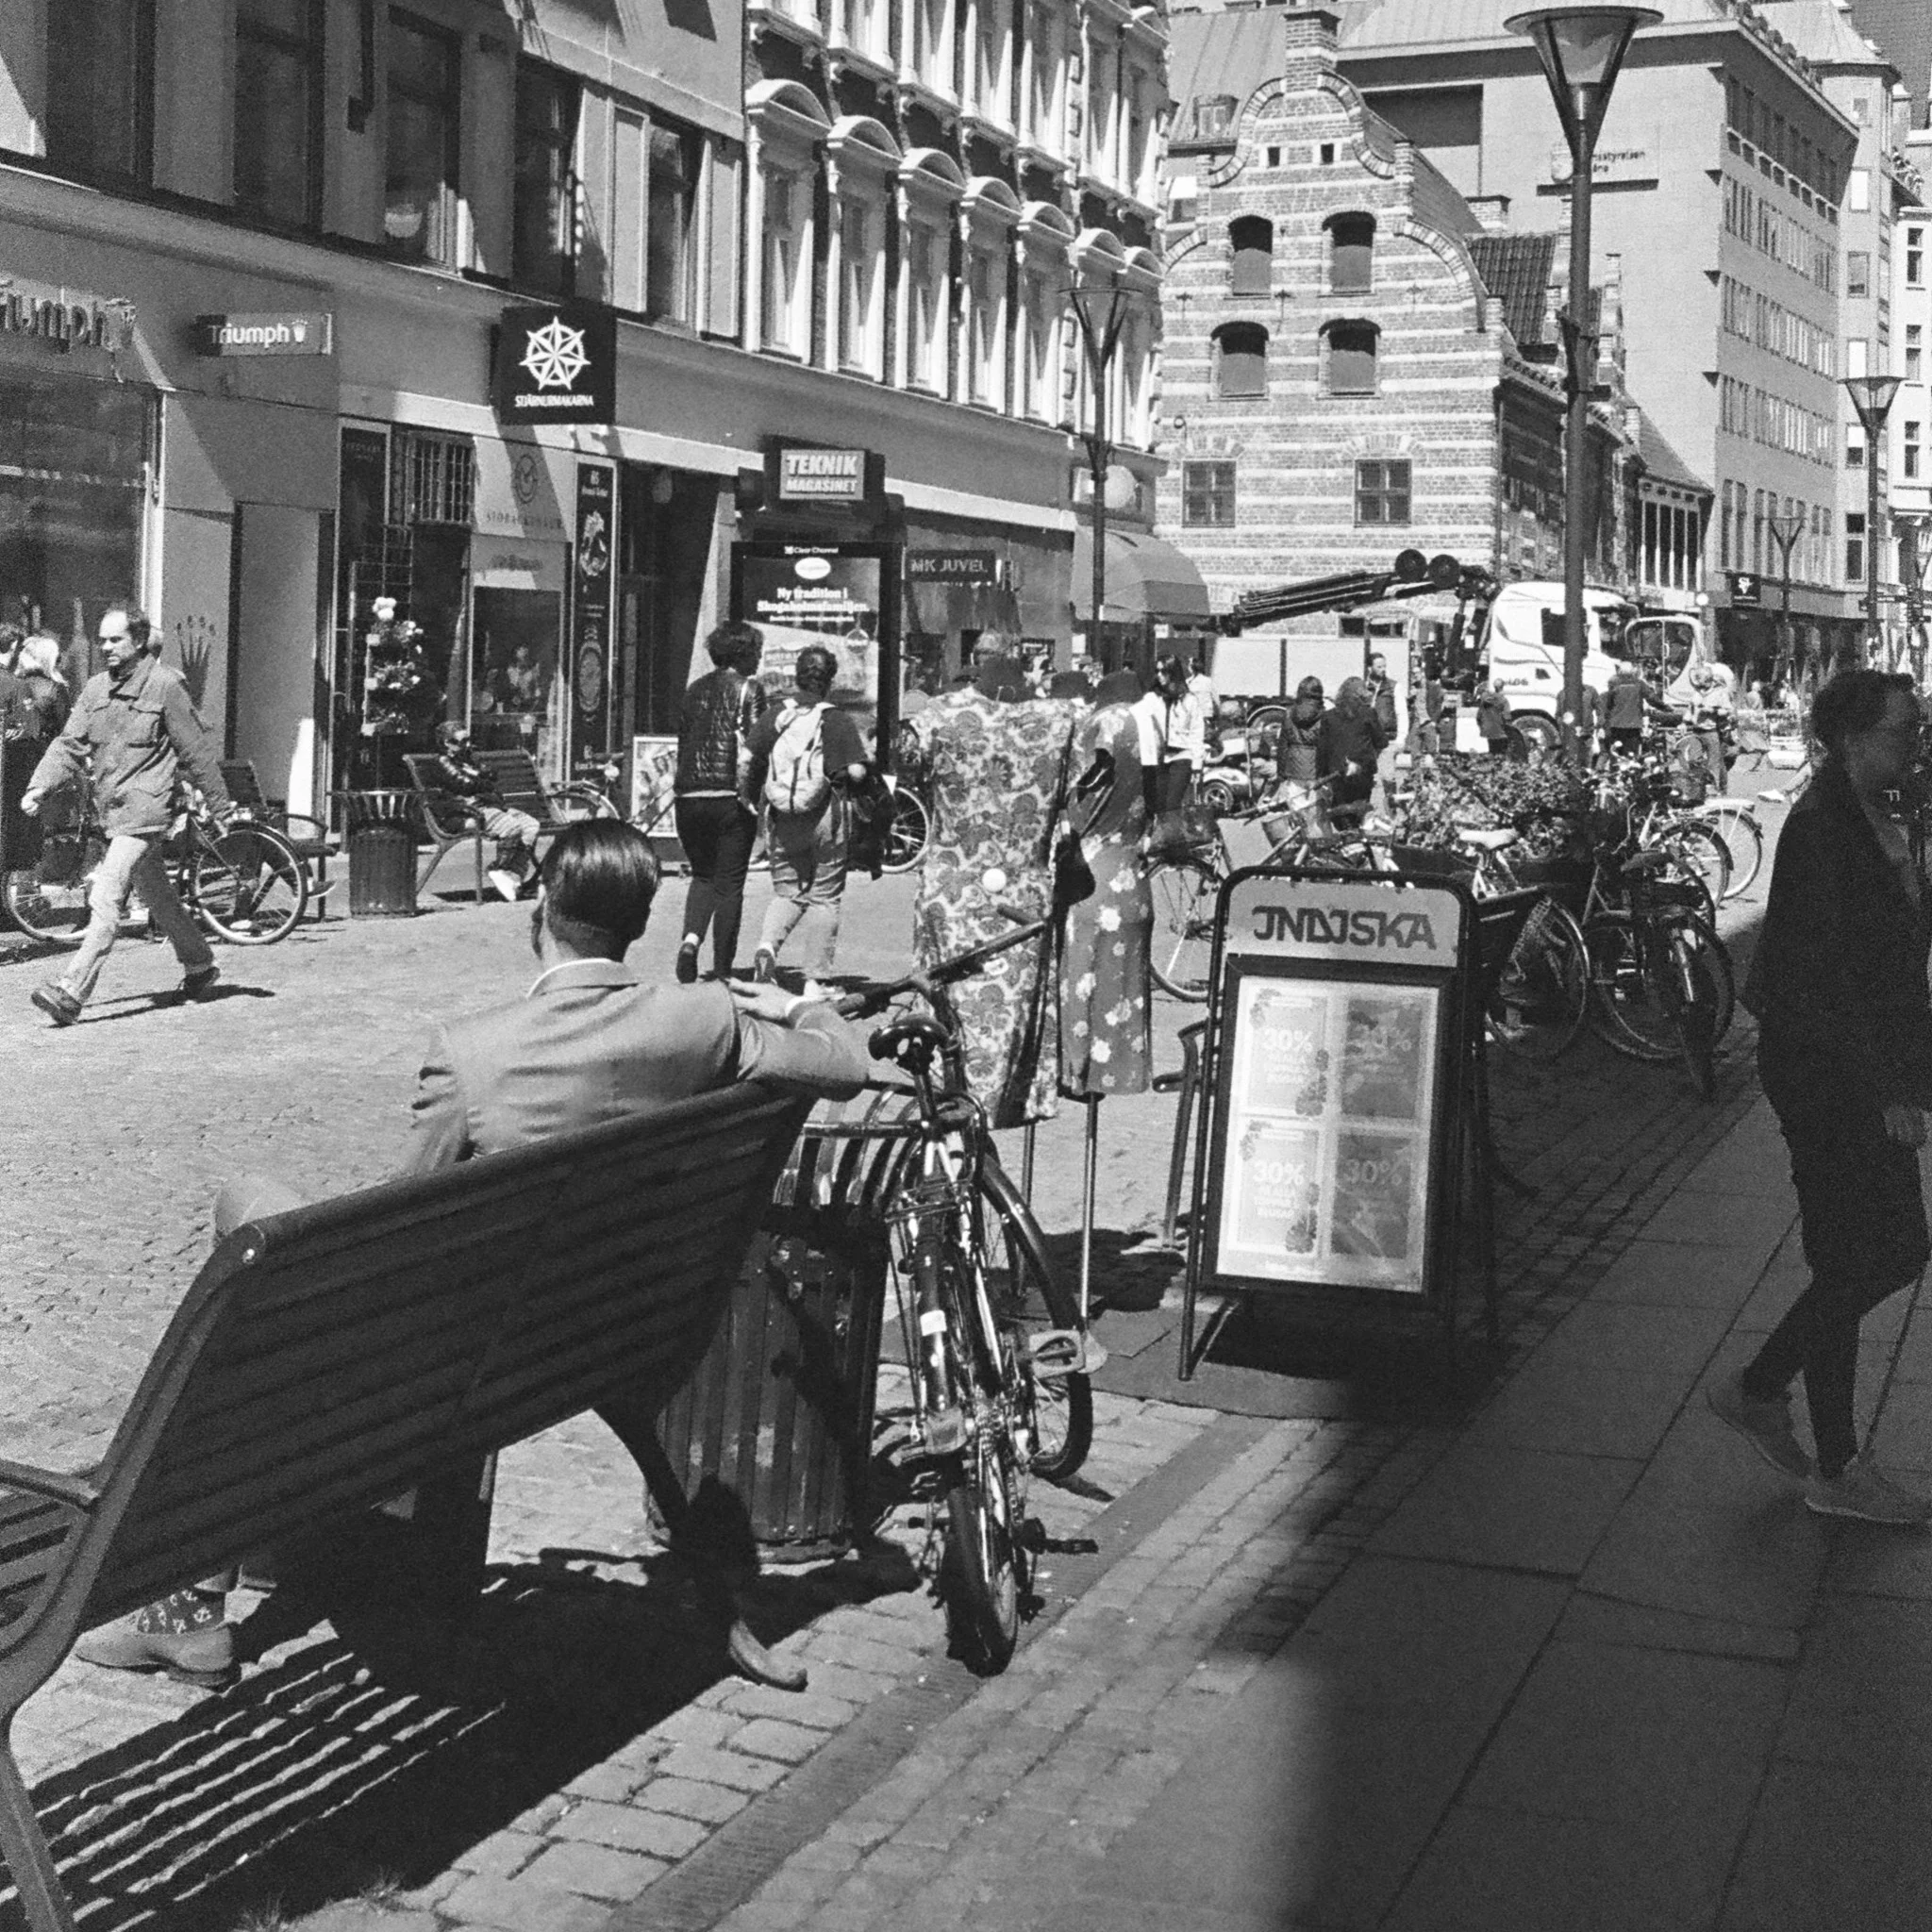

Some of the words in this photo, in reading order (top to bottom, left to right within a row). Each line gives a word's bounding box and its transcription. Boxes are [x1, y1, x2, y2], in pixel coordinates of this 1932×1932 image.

[0, 279, 108, 355] iumph
[207, 322, 291, 349] Triumph
[786, 454, 858, 475] TEKNIK
[785, 478, 858, 493] MAGASINET
[909, 558, 937, 573] MK
[939, 558, 989, 574] JUVEL
[776, 587, 792, 601] Ny
[793, 586, 841, 599] tradition
[1261, 1026, 1313, 1054] 30%
[1252, 1159, 1305, 1187] 30%
[1341, 1158, 1403, 1187] 30%
